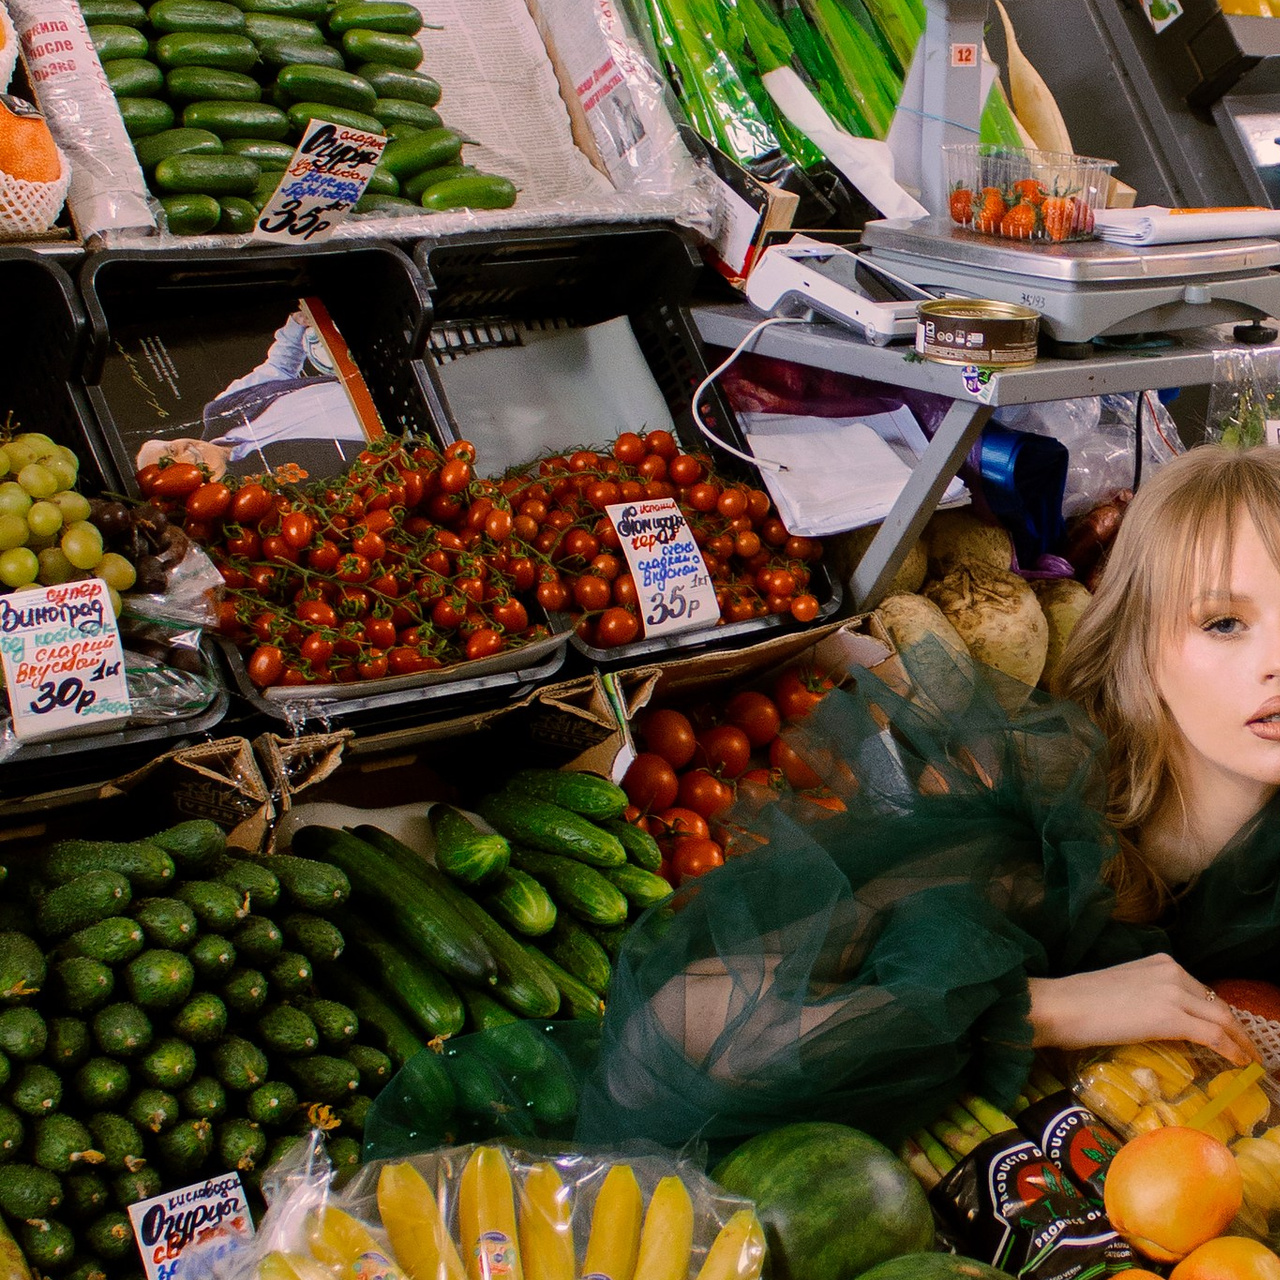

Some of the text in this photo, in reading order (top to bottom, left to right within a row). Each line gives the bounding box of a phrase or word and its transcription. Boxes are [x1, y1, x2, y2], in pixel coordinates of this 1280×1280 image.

[957, 48, 972, 63] 12
[259, 200, 331, 240] 35р
[46, 583, 102, 607] супер
[646, 585, 700, 626] 35р
[0, 599, 104, 632] Виноград
[30, 677, 96, 713] 30р
[1050, 1116, 1078, 1170] ODUCTO
[997, 1152, 1028, 1217] PRODUCTO
[141, 1197, 246, 1252] Огурцы
[1034, 1218, 1085, 1248] PRODUCE
